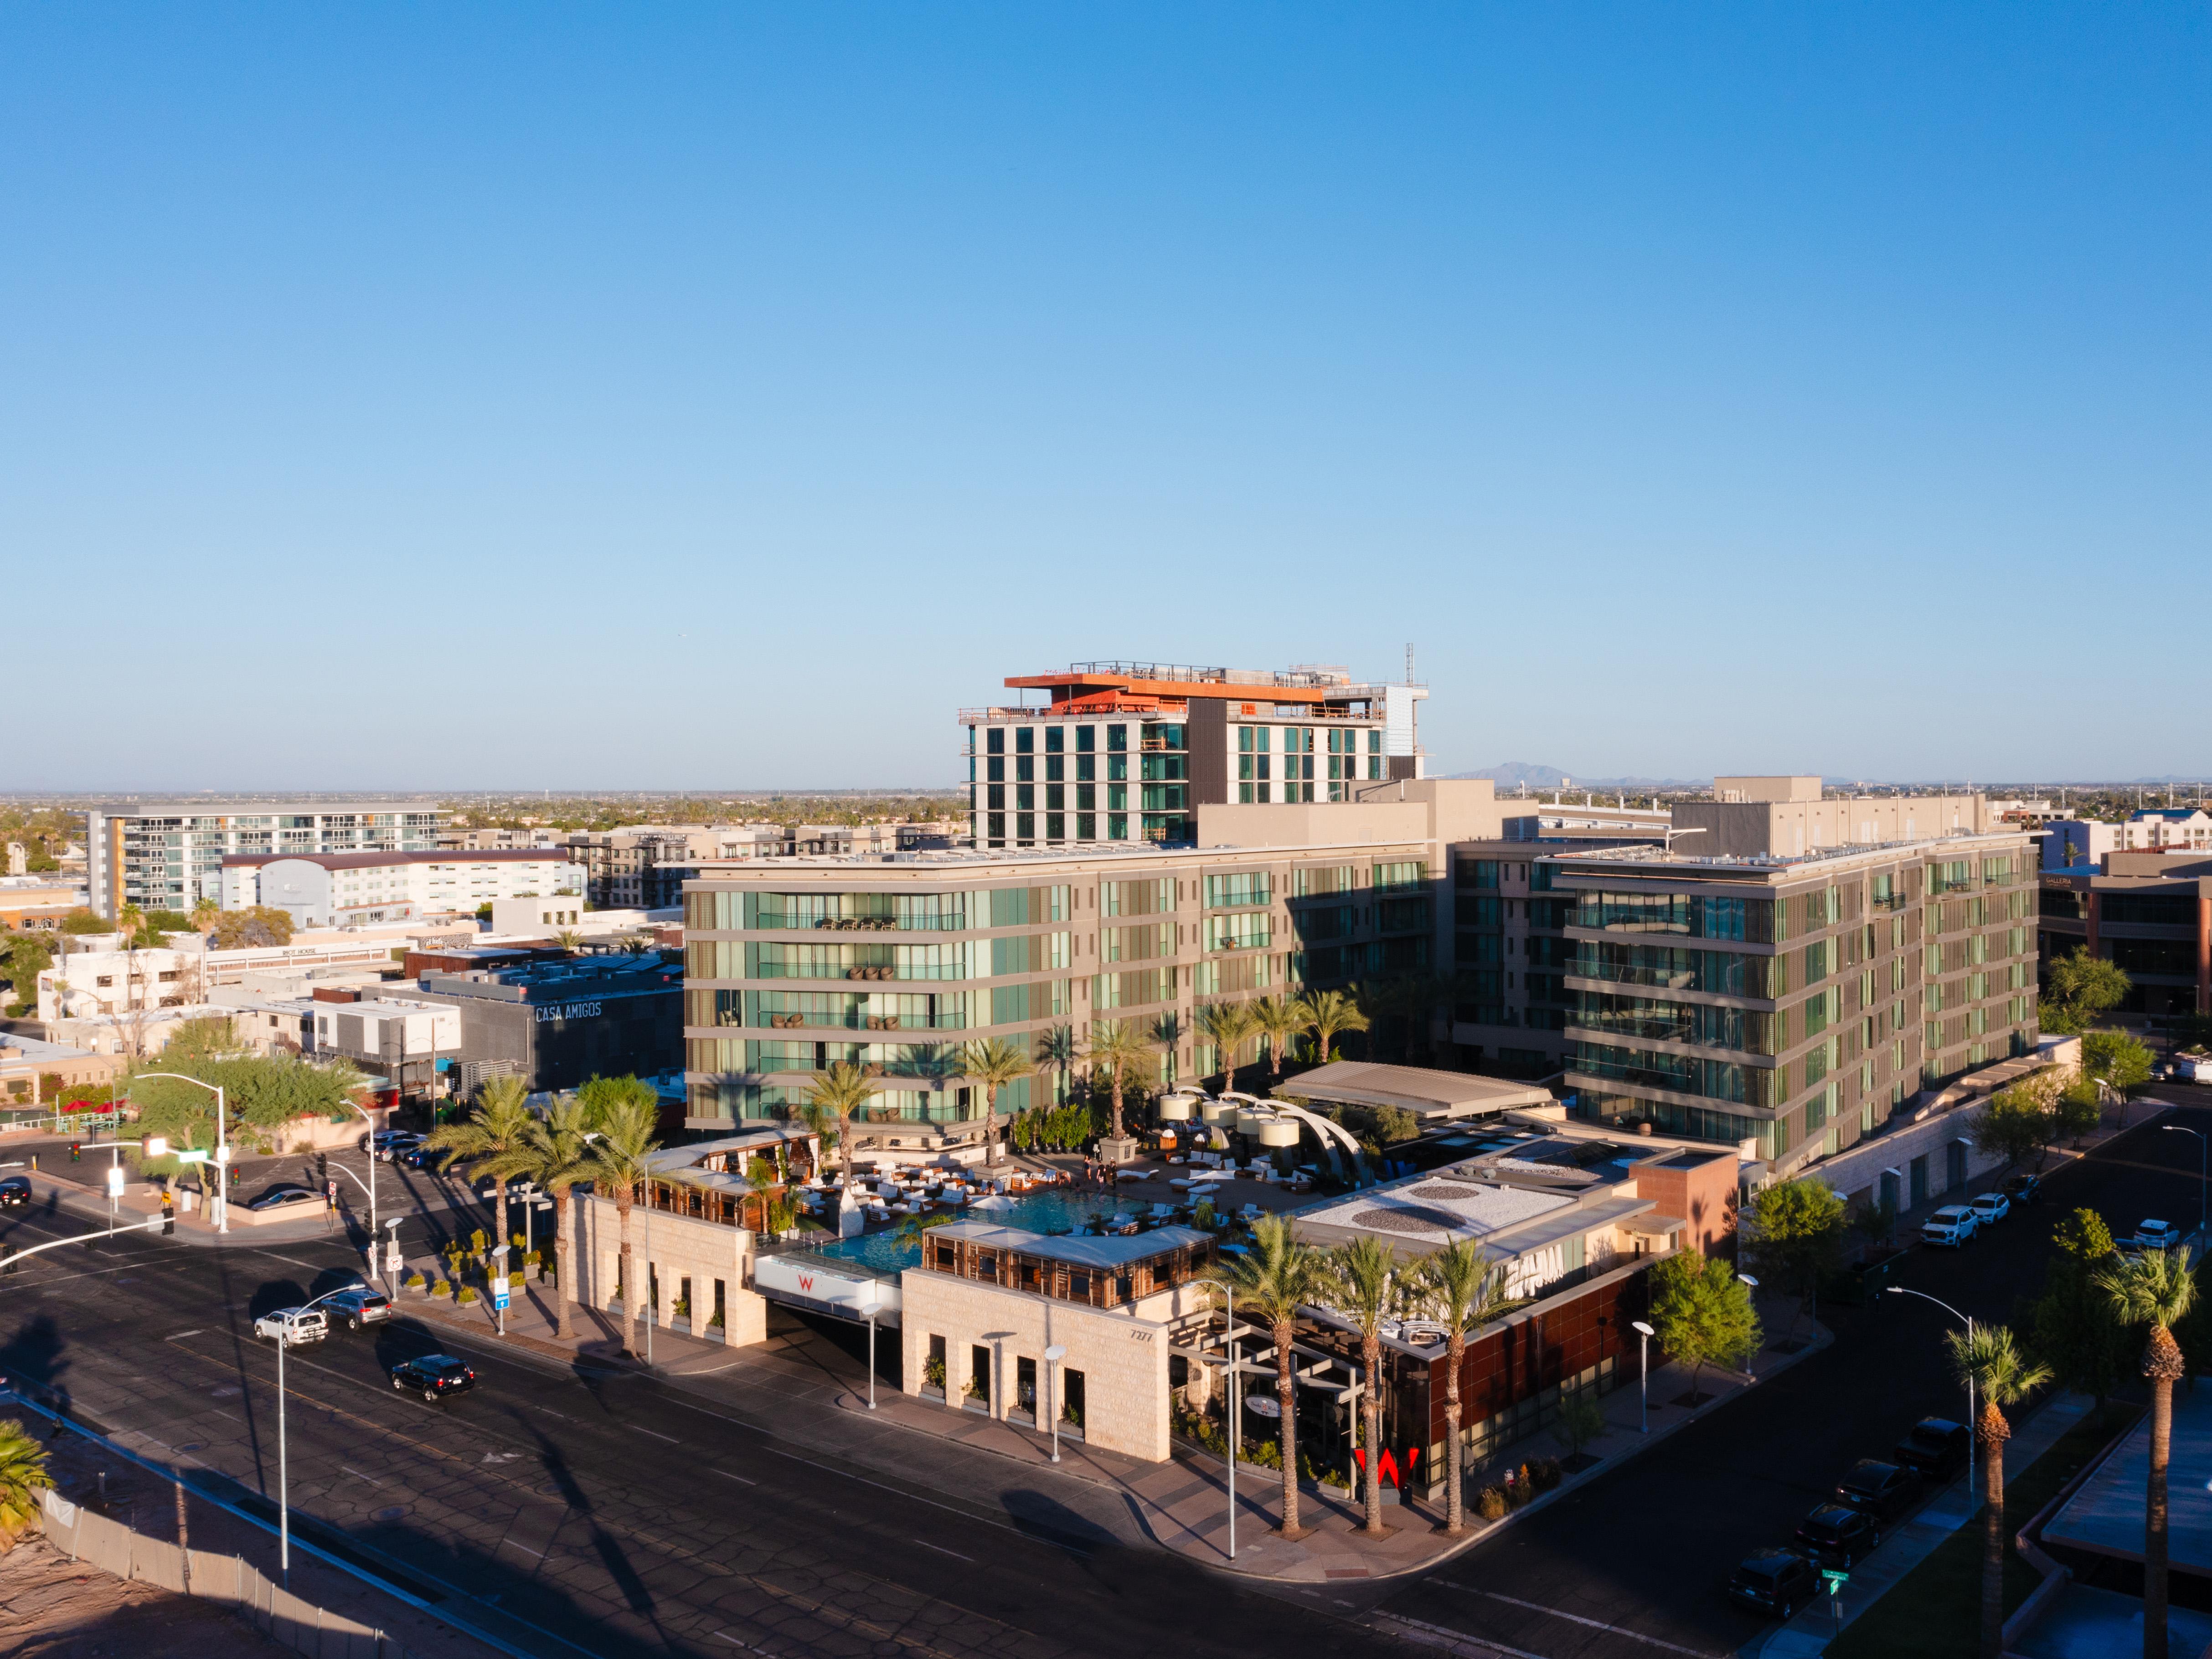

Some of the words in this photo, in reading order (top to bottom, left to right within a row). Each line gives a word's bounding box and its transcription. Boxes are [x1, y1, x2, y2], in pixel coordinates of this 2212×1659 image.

[2046, 877, 2072, 885] GALLERIA
[536, 1005, 562, 1022] CASA
[565, 1002, 601, 1020] AMIGOS
[798, 1274, 813, 1293] W
[1131, 1329, 1153, 1342] 7277
[1354, 1447, 1419, 1492] W
